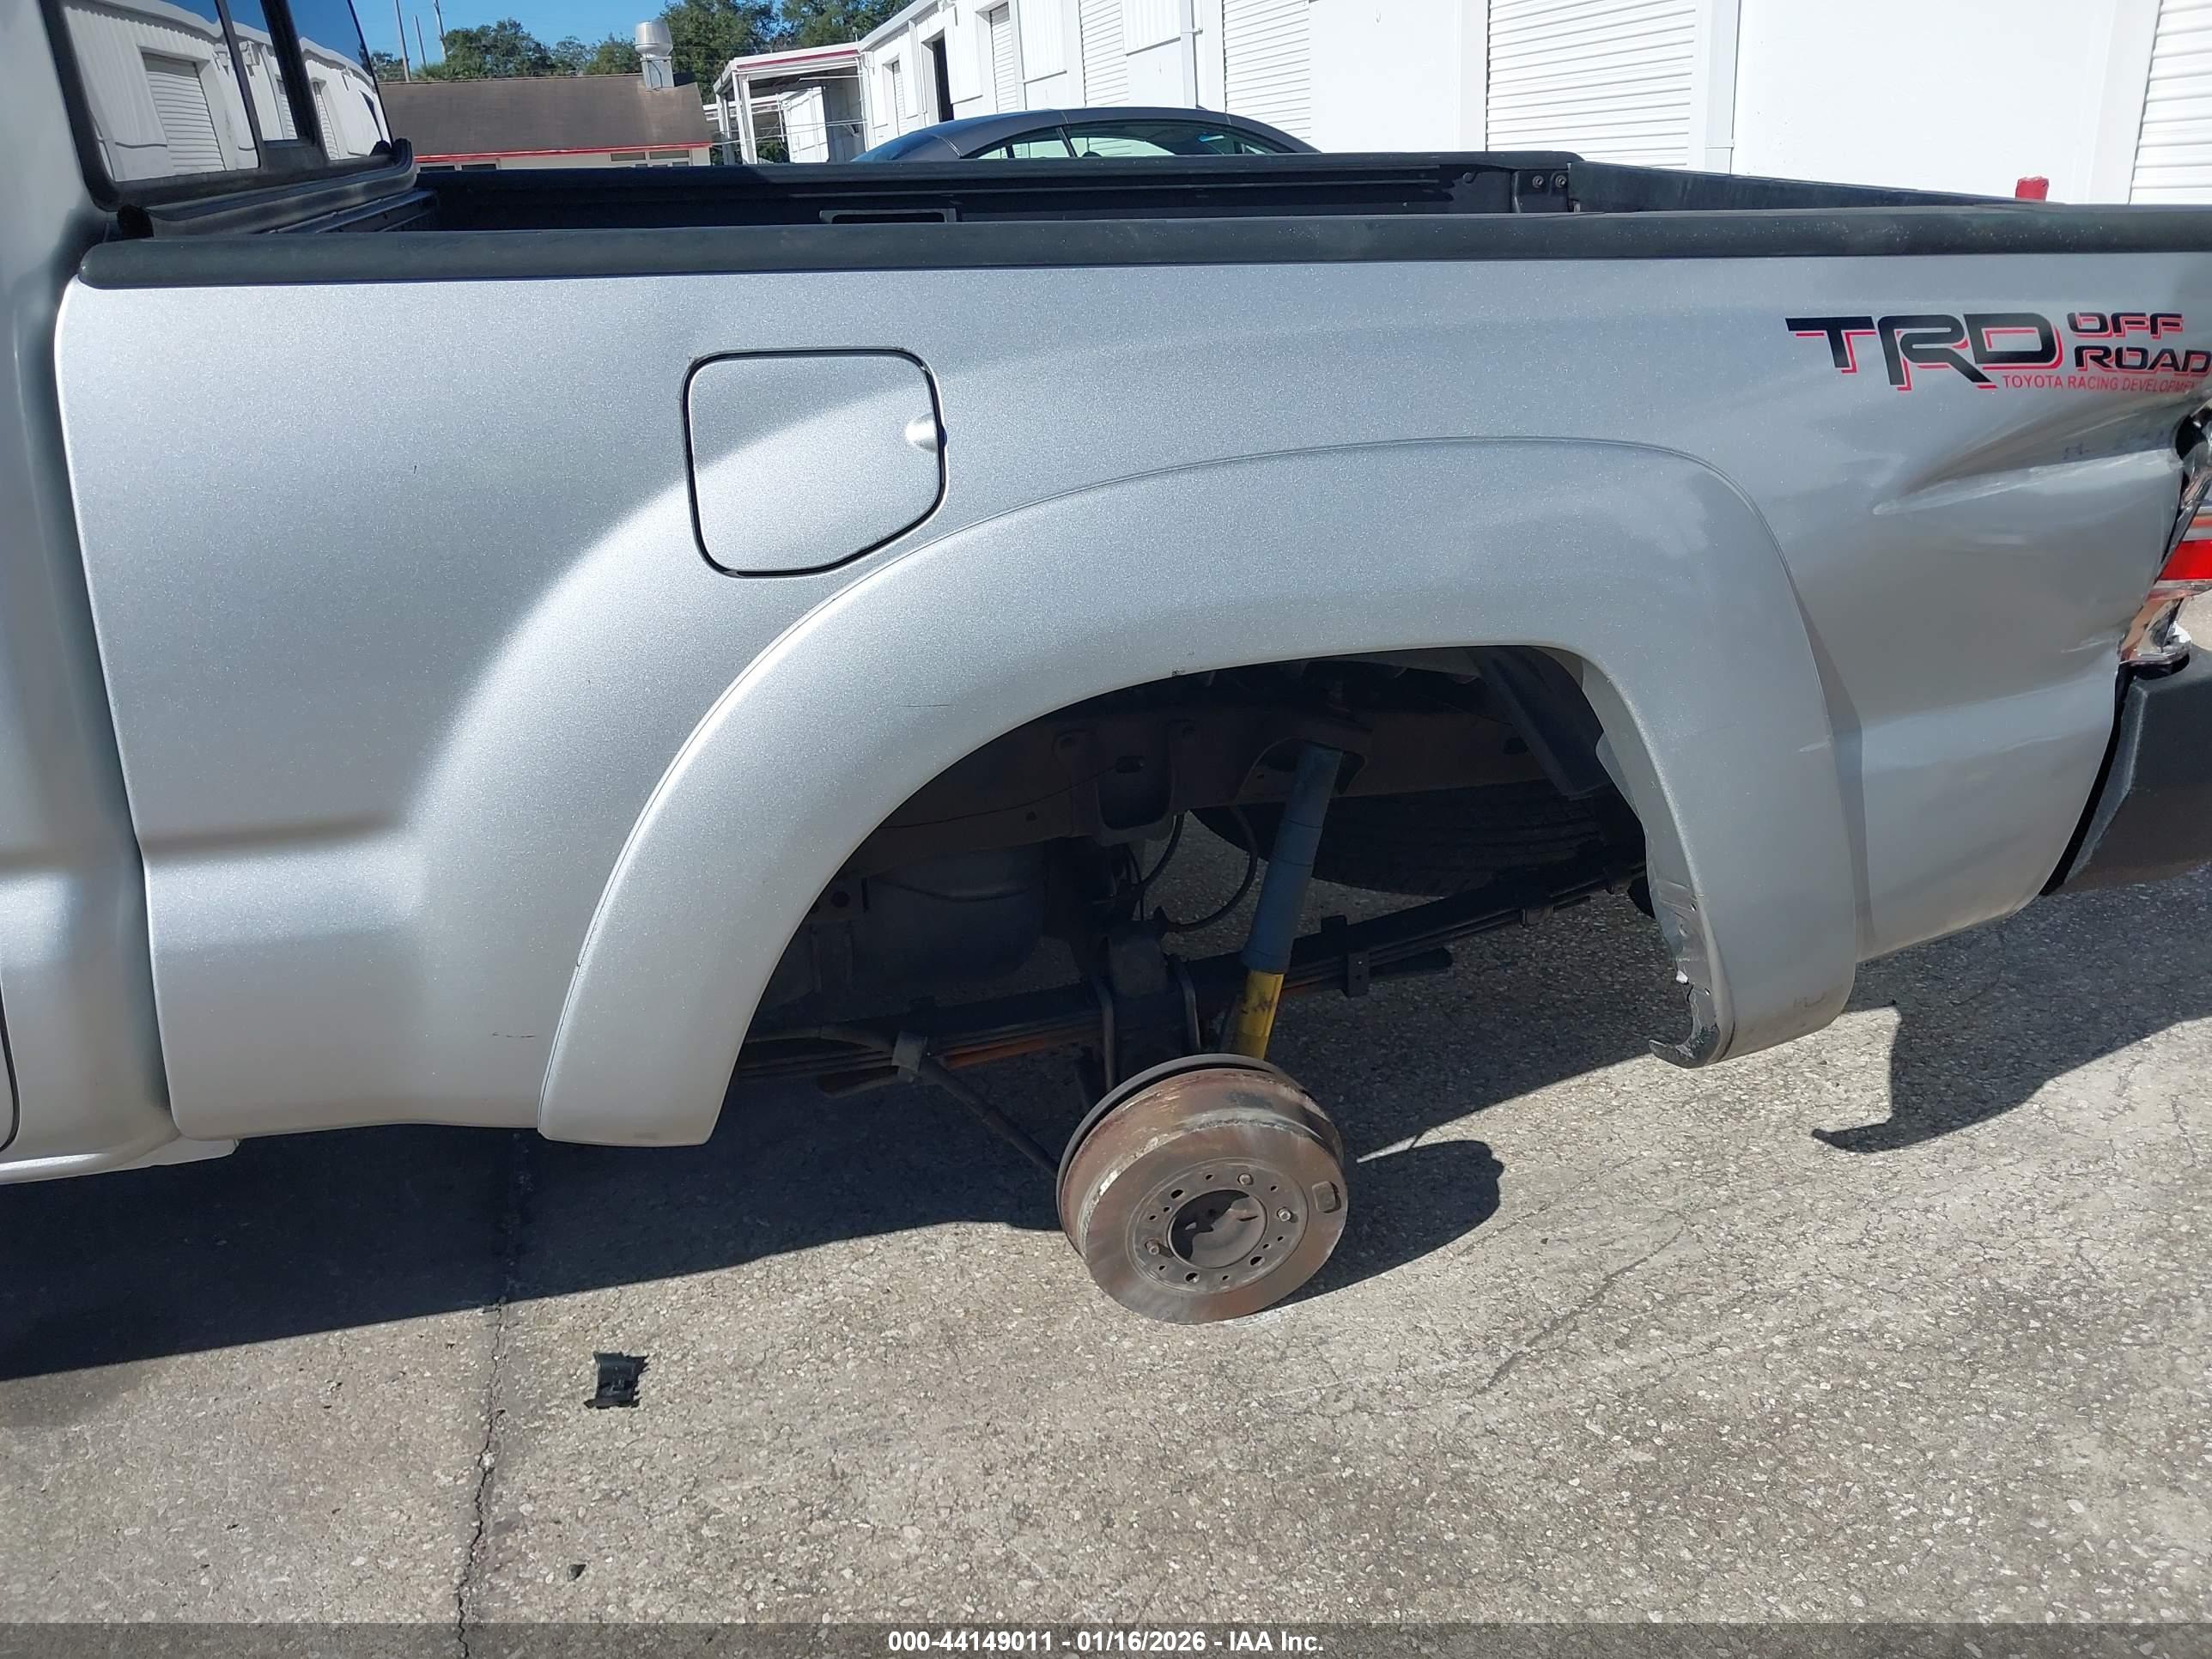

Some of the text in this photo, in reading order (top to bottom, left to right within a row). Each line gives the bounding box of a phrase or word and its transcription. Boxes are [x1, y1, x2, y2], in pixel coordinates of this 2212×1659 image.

[2067, 312, 2185, 340] OFF
[1784, 312, 2064, 392] TRD
[2074, 345, 2212, 378] ROAD
[2002, 374, 2063, 389] TOYOTA
[2067, 375, 2118, 391] RACING
